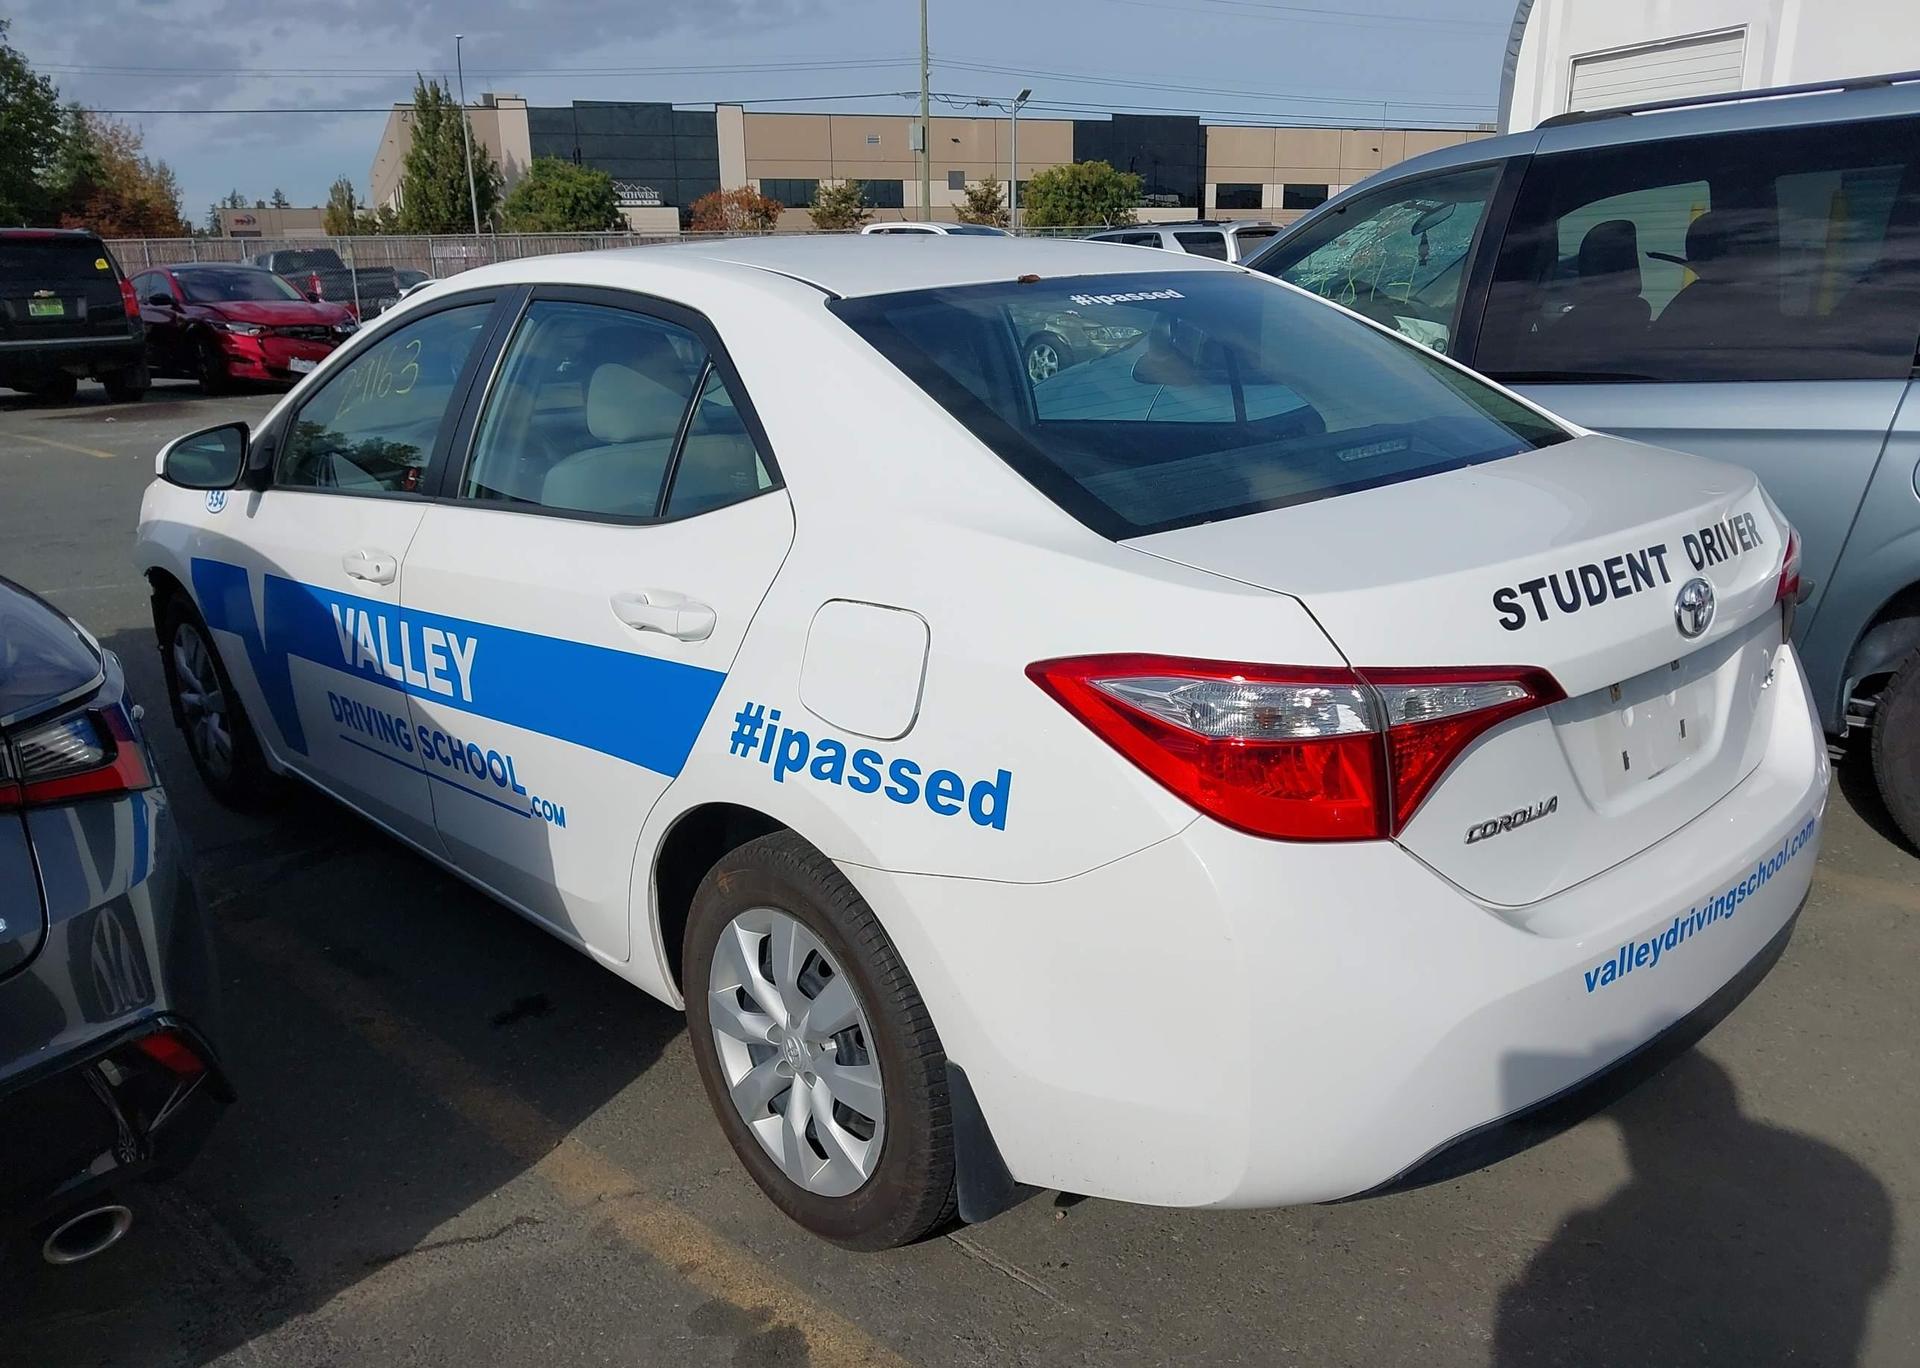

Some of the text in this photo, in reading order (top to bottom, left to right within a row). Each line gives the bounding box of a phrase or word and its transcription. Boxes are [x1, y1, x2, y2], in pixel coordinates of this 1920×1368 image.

[614, 191, 660, 199] RTHWEST
[1069, 289, 1186, 306] #ipassed
[1492, 512, 1764, 632] STUDENT DRIVER
[331, 603, 477, 702] VALLEY
[328, 691, 566, 828] DRIVING SCHOOL .COM
[729, 701, 1012, 831] #ipassed
[1464, 795, 1558, 844] COROLLA
[1584, 818, 1815, 994] valleydrivingschool.com
